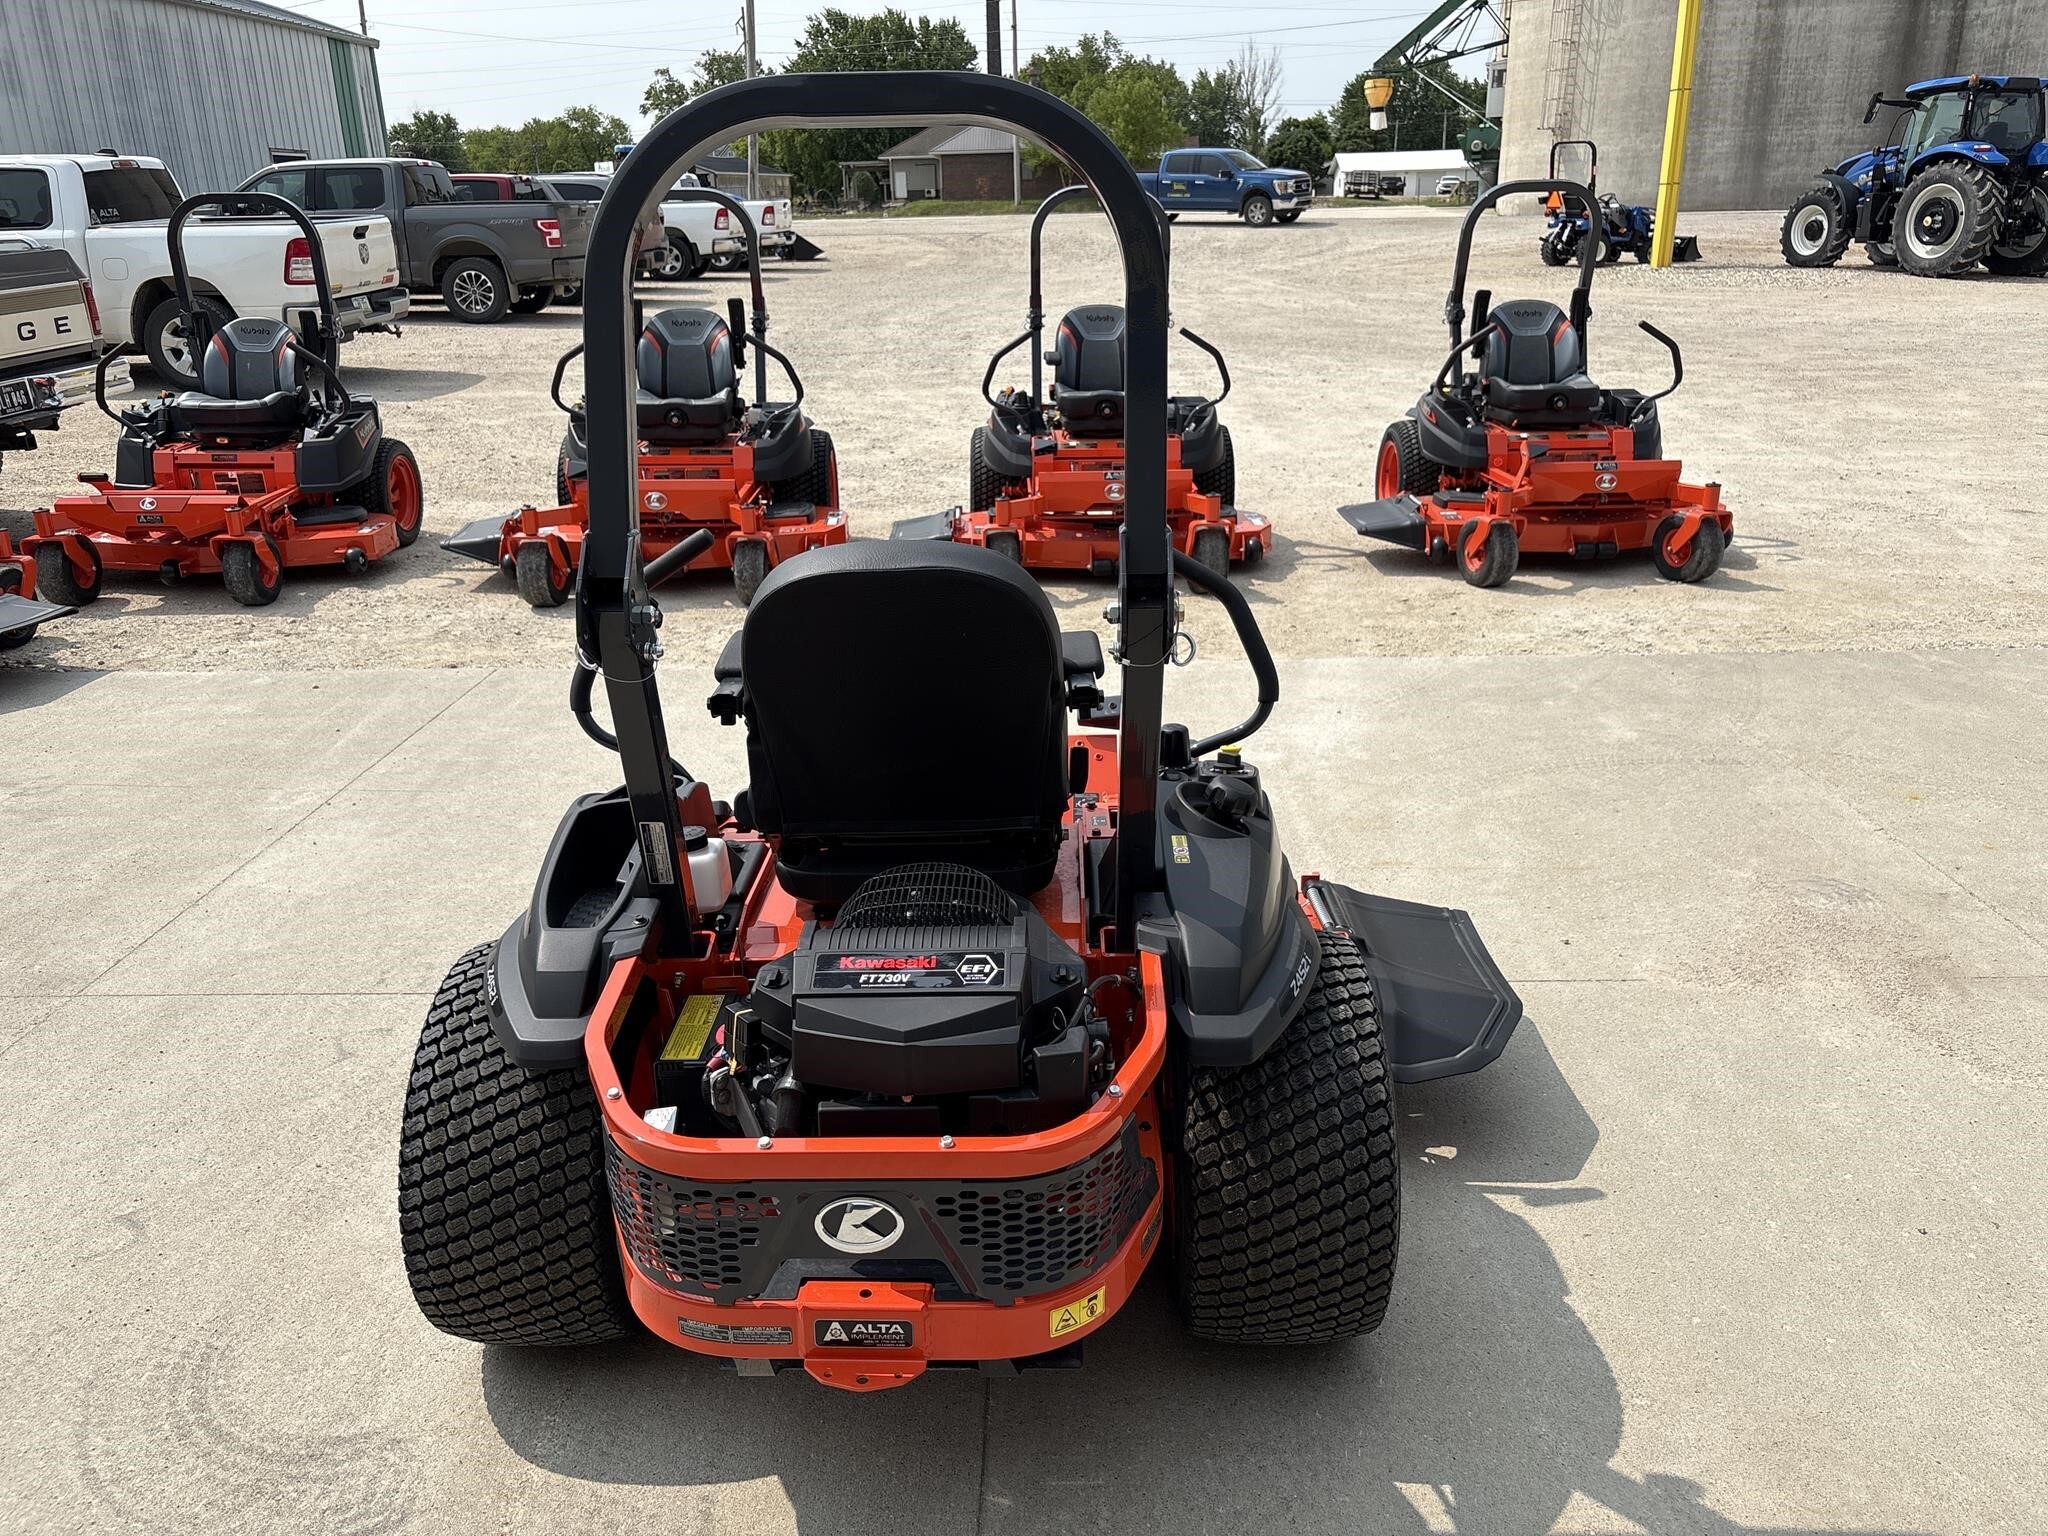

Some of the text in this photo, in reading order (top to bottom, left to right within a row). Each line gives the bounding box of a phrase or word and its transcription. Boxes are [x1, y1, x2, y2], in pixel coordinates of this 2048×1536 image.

[100, 208, 120, 217] ALTA
[671, 320, 702, 328] Kubota
[240, 326, 271, 335] Kubota
[0, 393, 12, 410] LH
[839, 955, 938, 970] Kawasaki
[960, 964, 992, 973] EFI
[859, 973, 911, 983] FT730V
[1290, 951, 1312, 998] Z452i
[851, 1323, 905, 1334] ALTA
